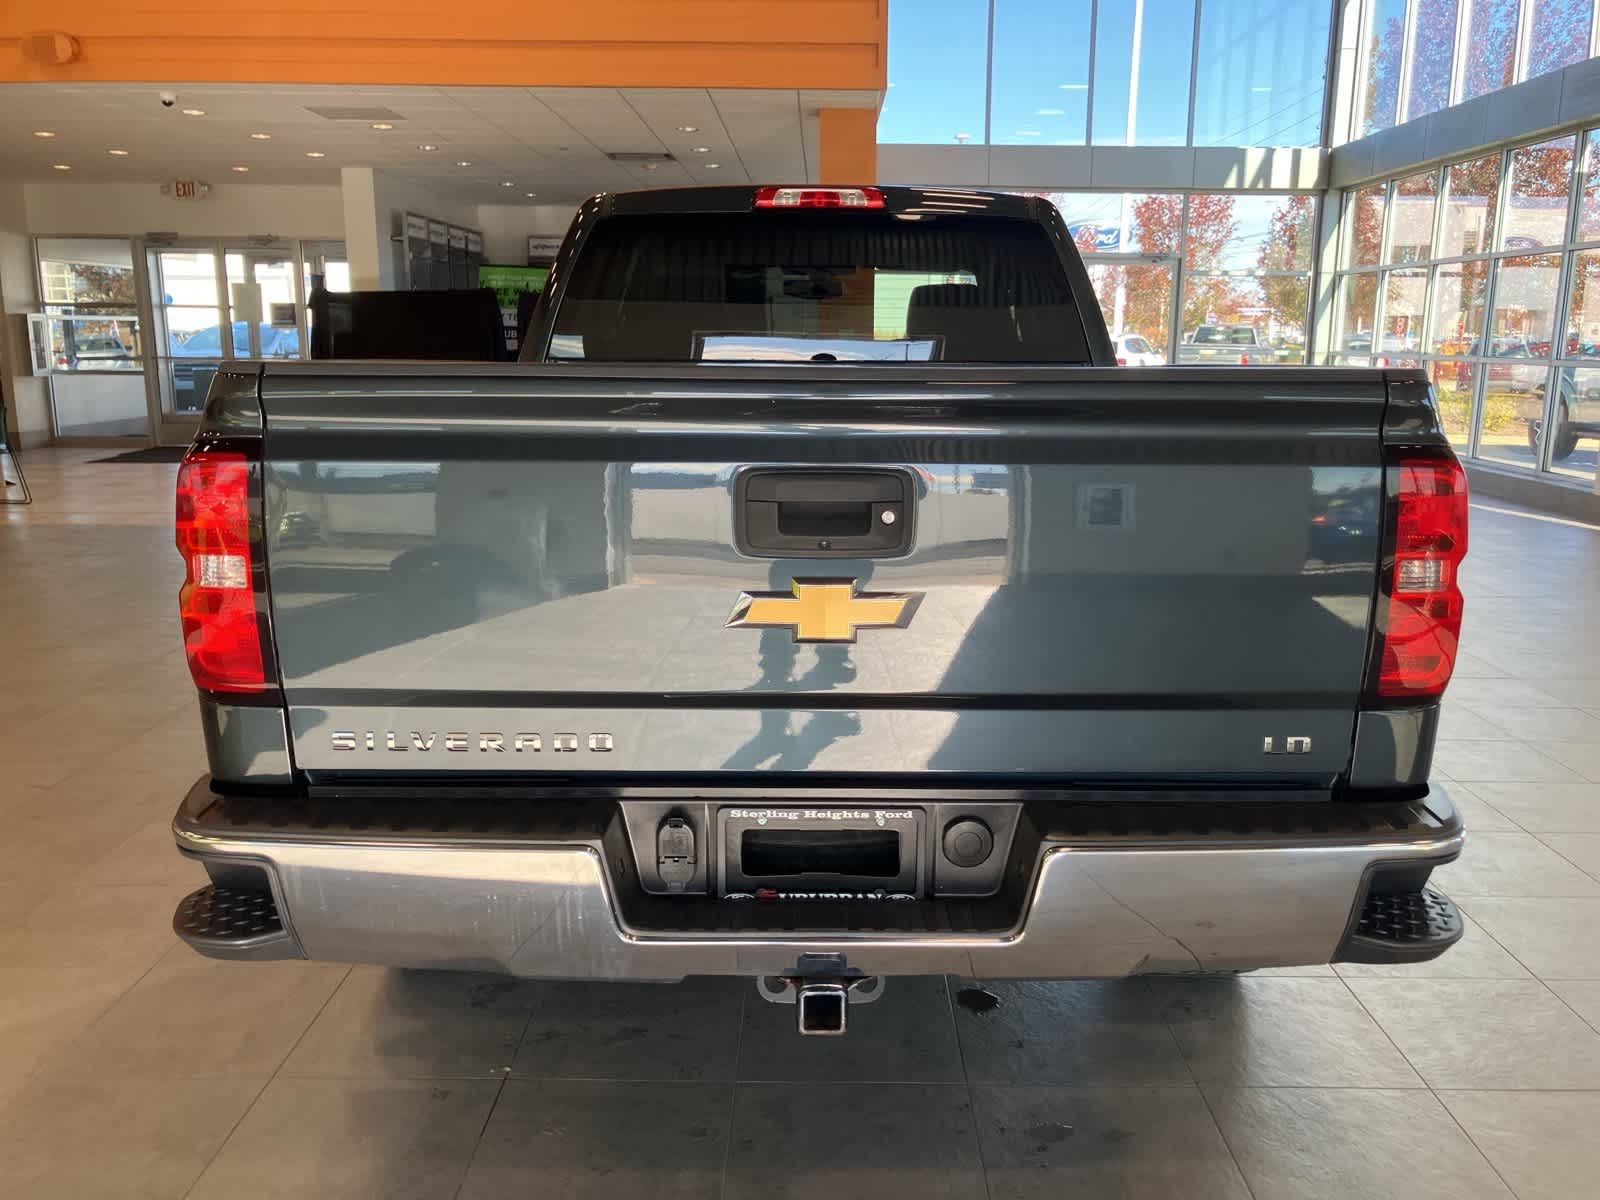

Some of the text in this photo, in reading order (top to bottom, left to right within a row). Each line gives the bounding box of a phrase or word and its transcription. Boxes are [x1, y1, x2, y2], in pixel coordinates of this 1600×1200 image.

[175, 180, 195, 198] EXIT
[331, 731, 614, 752] SILVERADO
[1263, 736, 1311, 753] LD
[729, 809, 913, 820] Sterling Heights Ford
